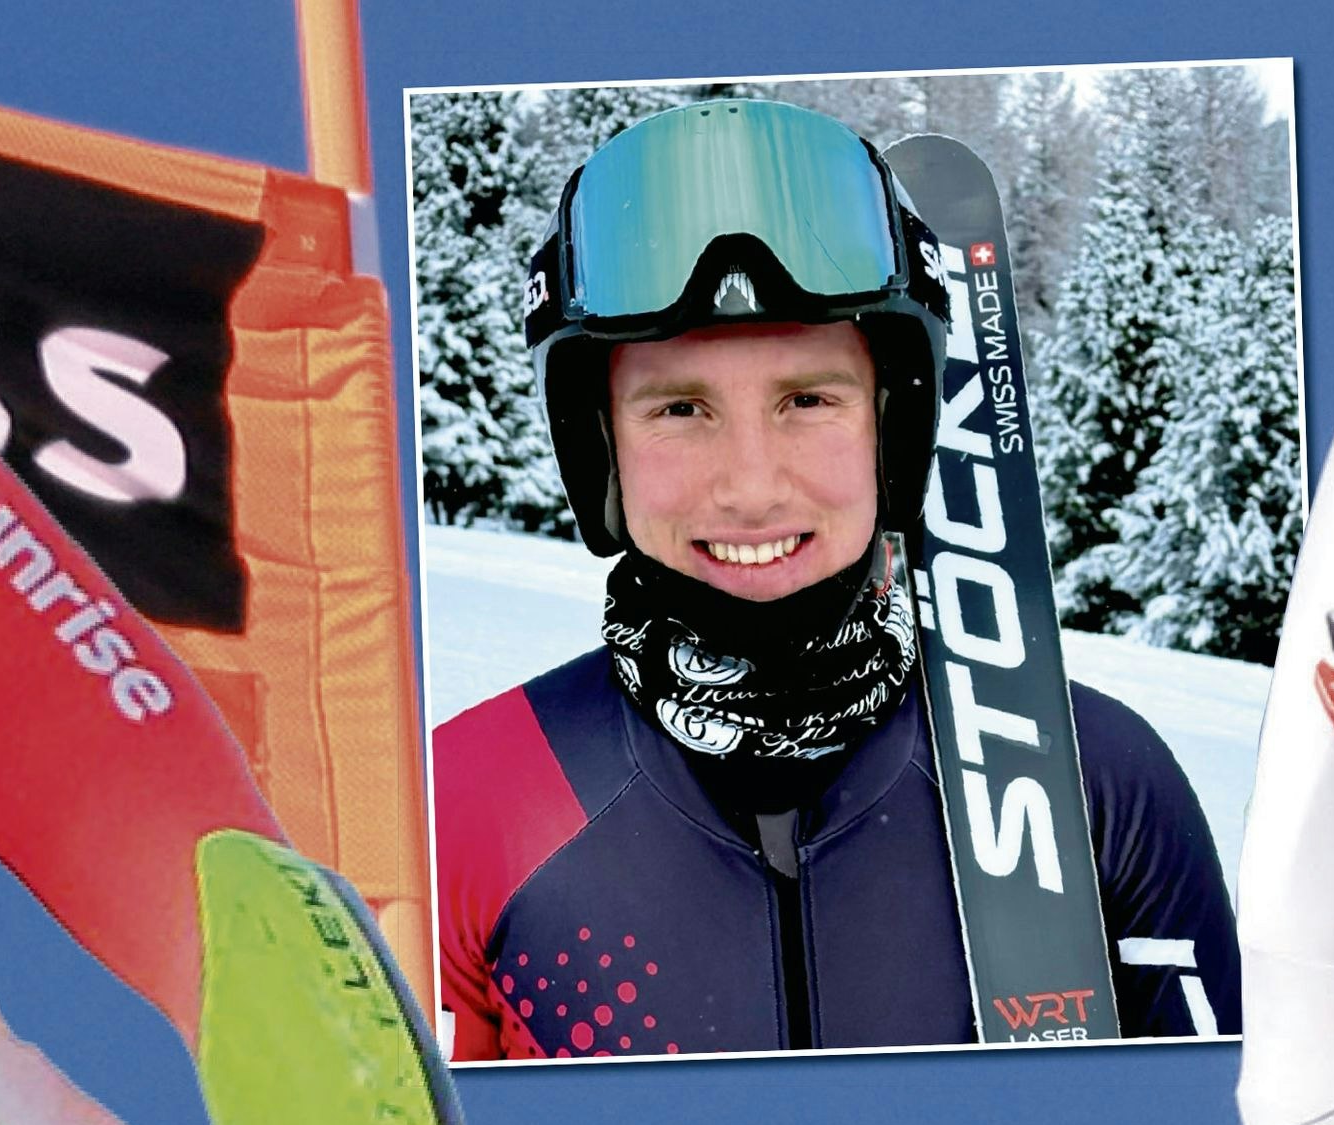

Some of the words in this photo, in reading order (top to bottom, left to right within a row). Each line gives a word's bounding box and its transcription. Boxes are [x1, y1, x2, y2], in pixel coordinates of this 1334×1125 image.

[974, 270, 1009, 361] MADE
[988, 365, 1024, 455] SWISS
[993, 988, 1095, 1031] WRT
